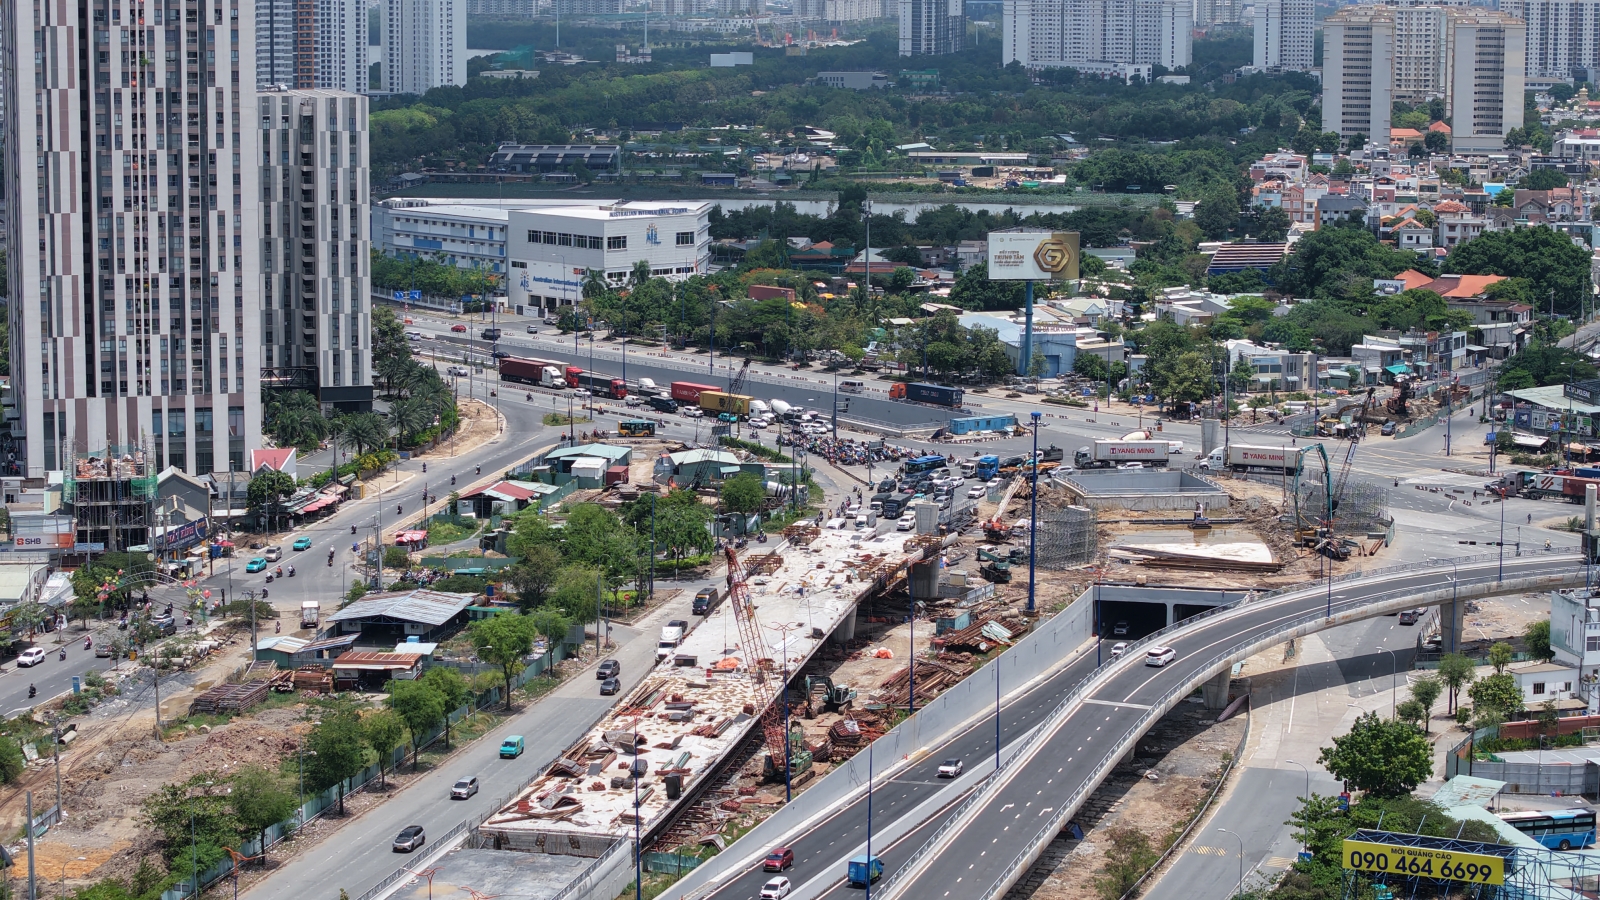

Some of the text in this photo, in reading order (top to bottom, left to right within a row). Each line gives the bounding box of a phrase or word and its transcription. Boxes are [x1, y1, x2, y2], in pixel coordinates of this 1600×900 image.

[610, 208, 687, 218] AUSTRALIAN INTERNATIONAL SCHOOL
[533, 276, 552, 284] Australian
[553, 278, 578, 287] International
[1391, 847, 1452, 862] MỜI QUẢNG CÁO
[1350, 851, 1493, 882] 090 464 6699
